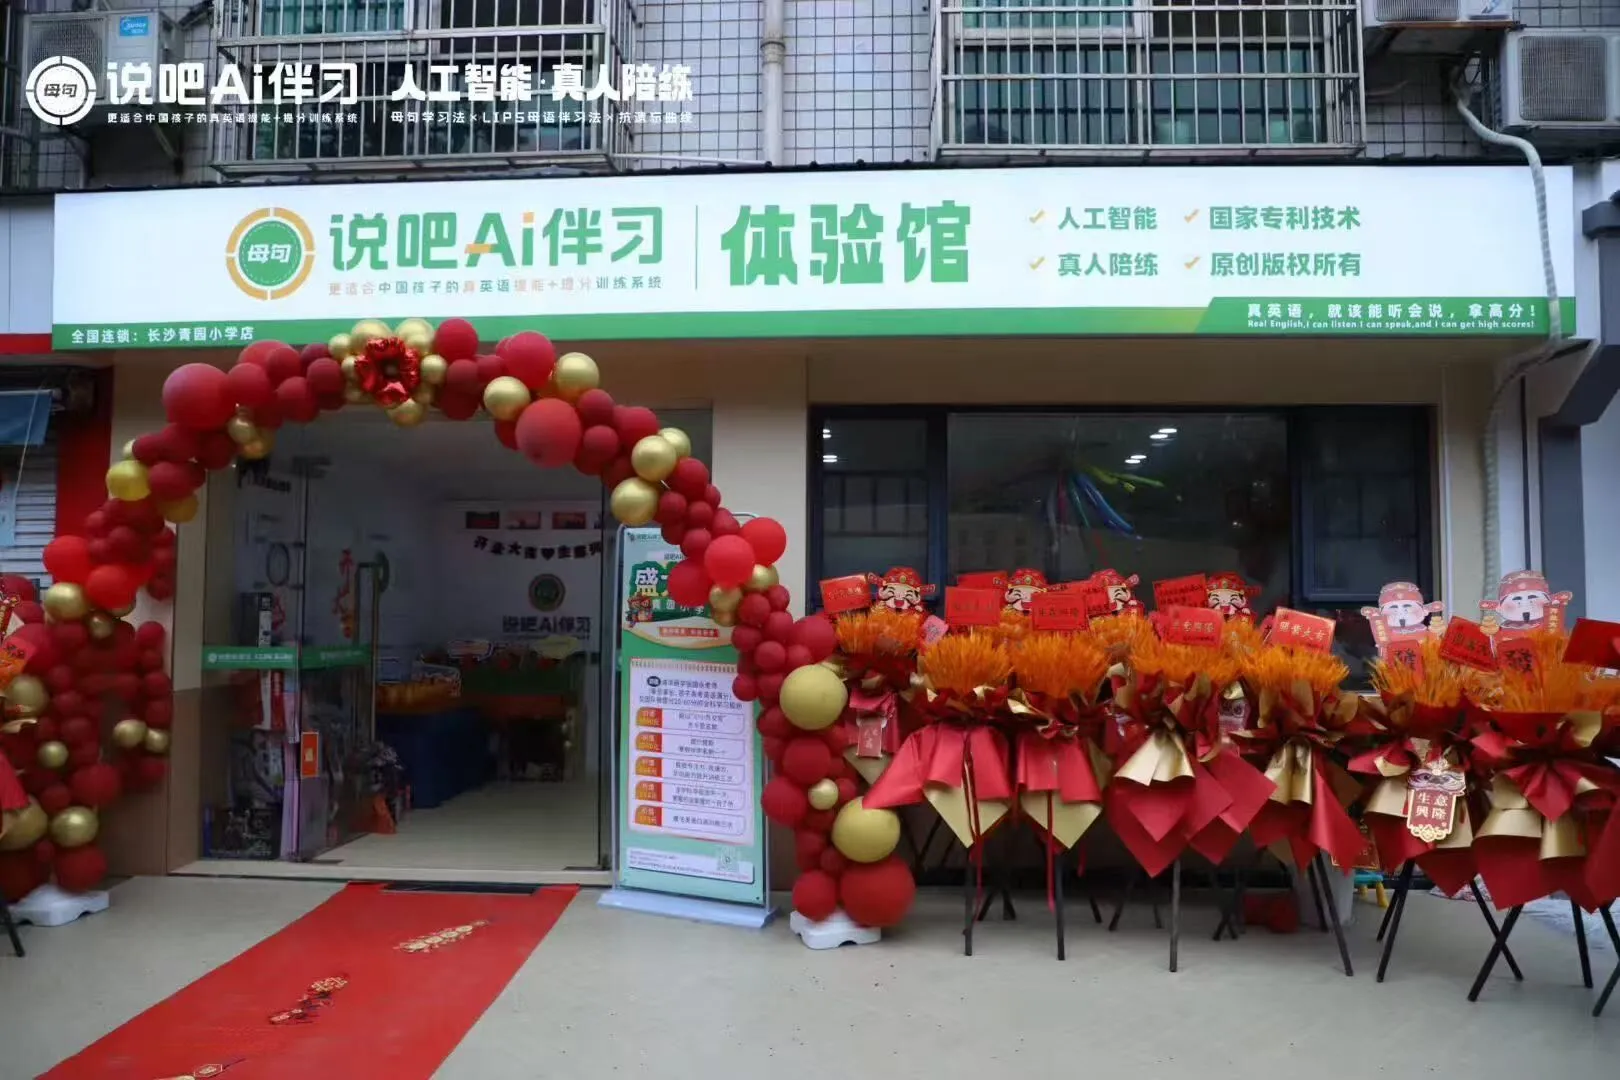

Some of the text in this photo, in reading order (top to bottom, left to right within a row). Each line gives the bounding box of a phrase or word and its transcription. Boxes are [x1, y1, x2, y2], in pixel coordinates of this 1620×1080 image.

[1058, 206, 1158, 230] 人工智能
[1209, 205, 1361, 230] 国家专利技术
[329, 207, 662, 271] 说吧Ai伴习
[721, 200, 971, 286] 体验馆
[247, 243, 293, 264] 母句
[1057, 252, 1158, 277] 真人陪练
[1210, 252, 1361, 277] 原创版权所有
[328, 276, 663, 296] 更适合中国孩子的真英语提能+提分训练系统
[1248, 320, 1267, 328] Real
[1331, 320, 1357, 328] listen
[1460, 321, 1475, 330] get
[1478, 320, 1499, 330] high
[1501, 320, 1535, 328] scores!
